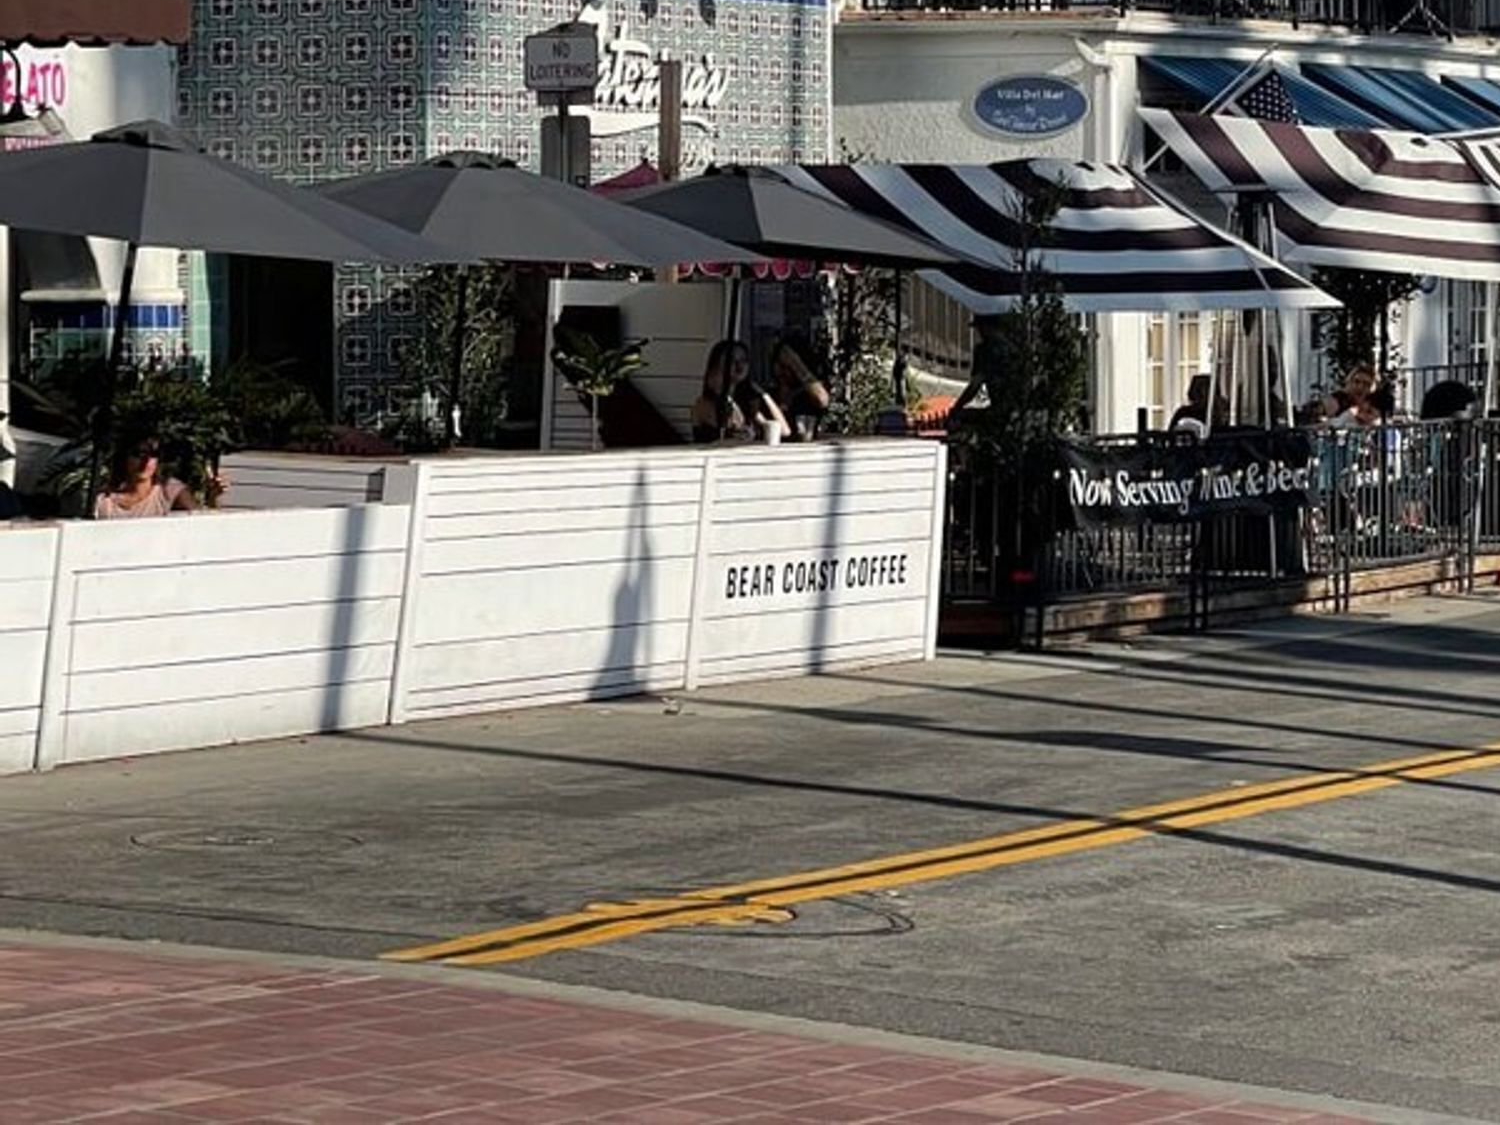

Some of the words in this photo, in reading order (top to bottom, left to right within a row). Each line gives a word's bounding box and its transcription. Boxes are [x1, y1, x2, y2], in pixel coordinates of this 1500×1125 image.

[552, 42, 571, 59] NO
[530, 62, 593, 81] LOITERING
[1069, 468, 1112, 507] Now
[1116, 470, 1196, 515] Serving
[1200, 467, 1243, 501] Wine
[1245, 462, 1264, 495] &
[726, 565, 775, 599] BEAR
[782, 560, 839, 593] COAST
[845, 554, 907, 588] COFFEE
